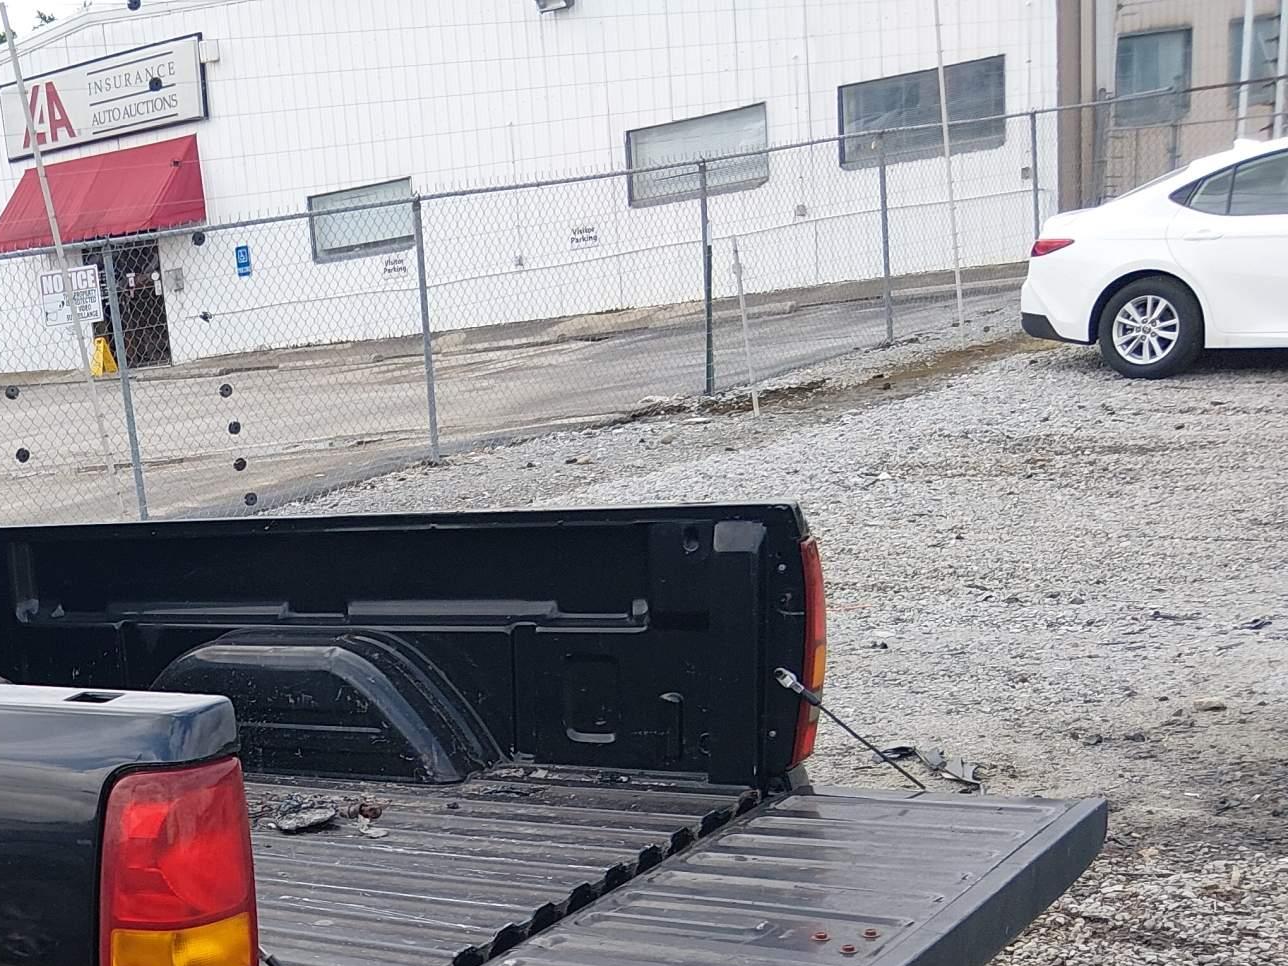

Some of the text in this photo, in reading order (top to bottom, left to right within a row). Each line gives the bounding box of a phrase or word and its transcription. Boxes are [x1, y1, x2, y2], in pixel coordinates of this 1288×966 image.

[88, 61, 176, 96] INSURANCE
[92, 93, 178, 126] AUTO AUCTIONS
[43, 270, 96, 295] NOICE
